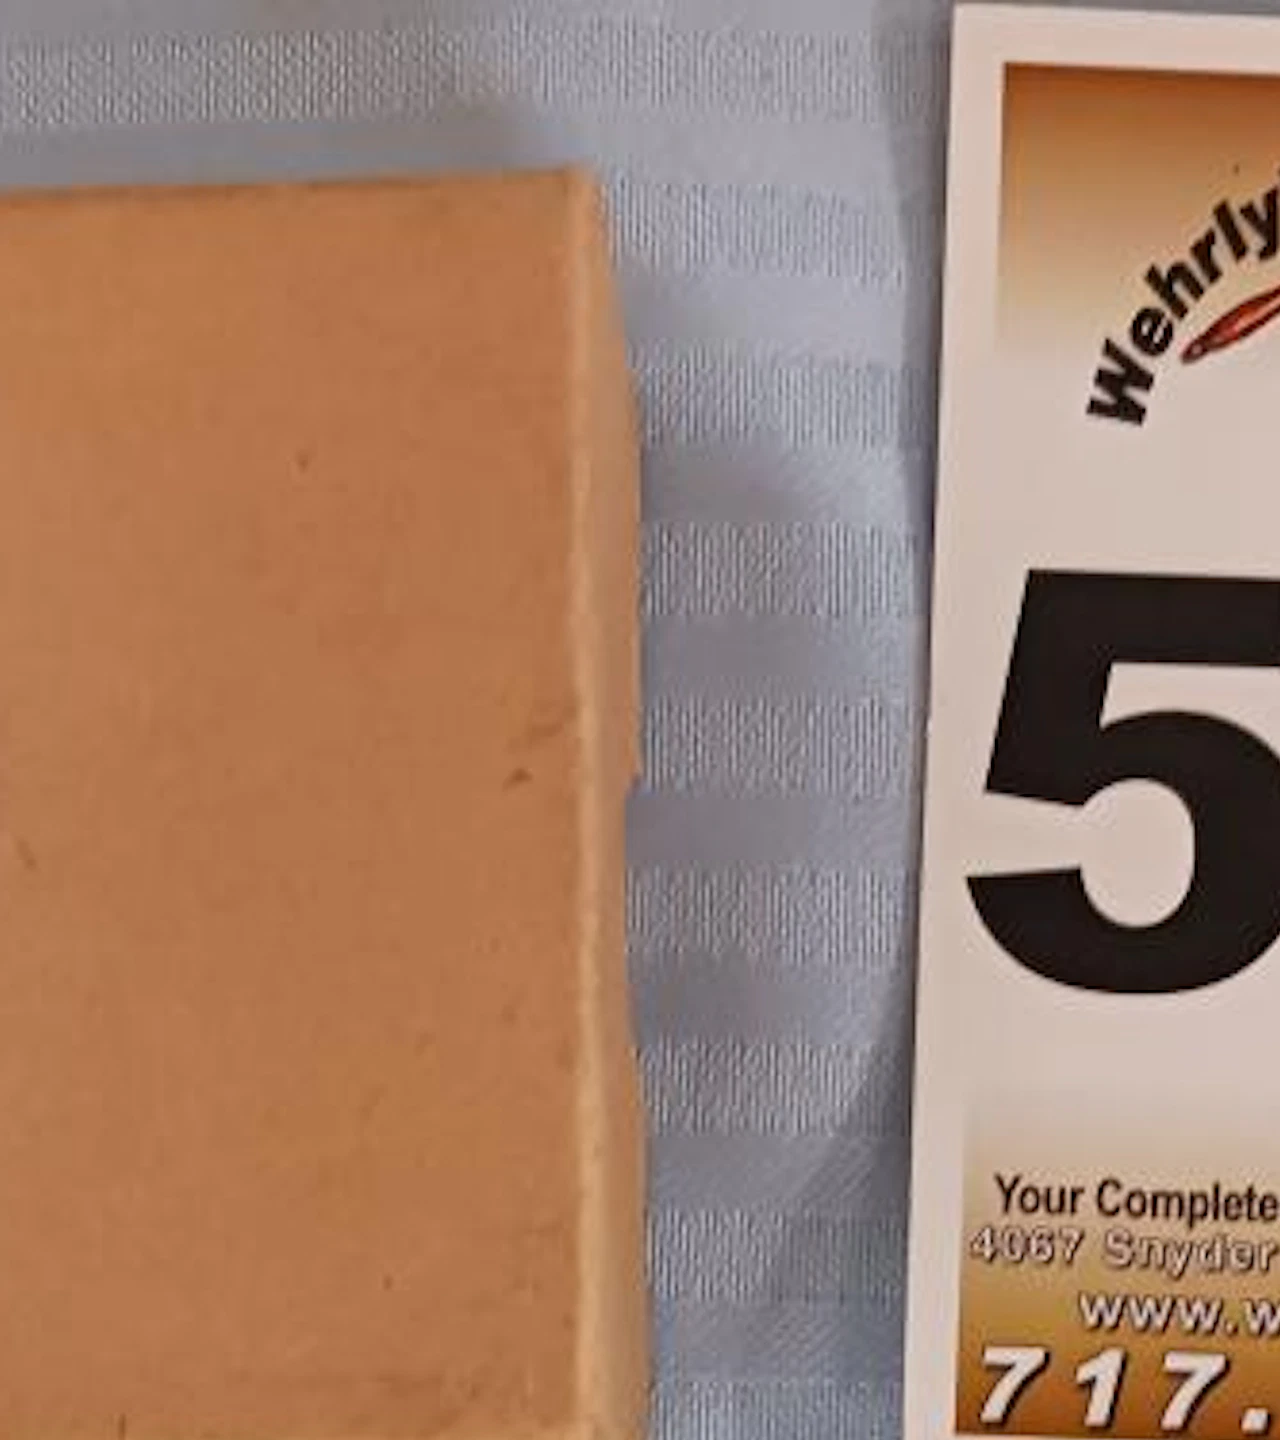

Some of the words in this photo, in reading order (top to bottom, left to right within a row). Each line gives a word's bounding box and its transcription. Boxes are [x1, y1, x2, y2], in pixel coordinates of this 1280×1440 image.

[994, 1174, 1084, 1216] Your
[1097, 1178, 1278, 1229] Complete
[969, 1225, 1086, 1265] 4067
[1105, 1228, 1280, 1278] Snyder
